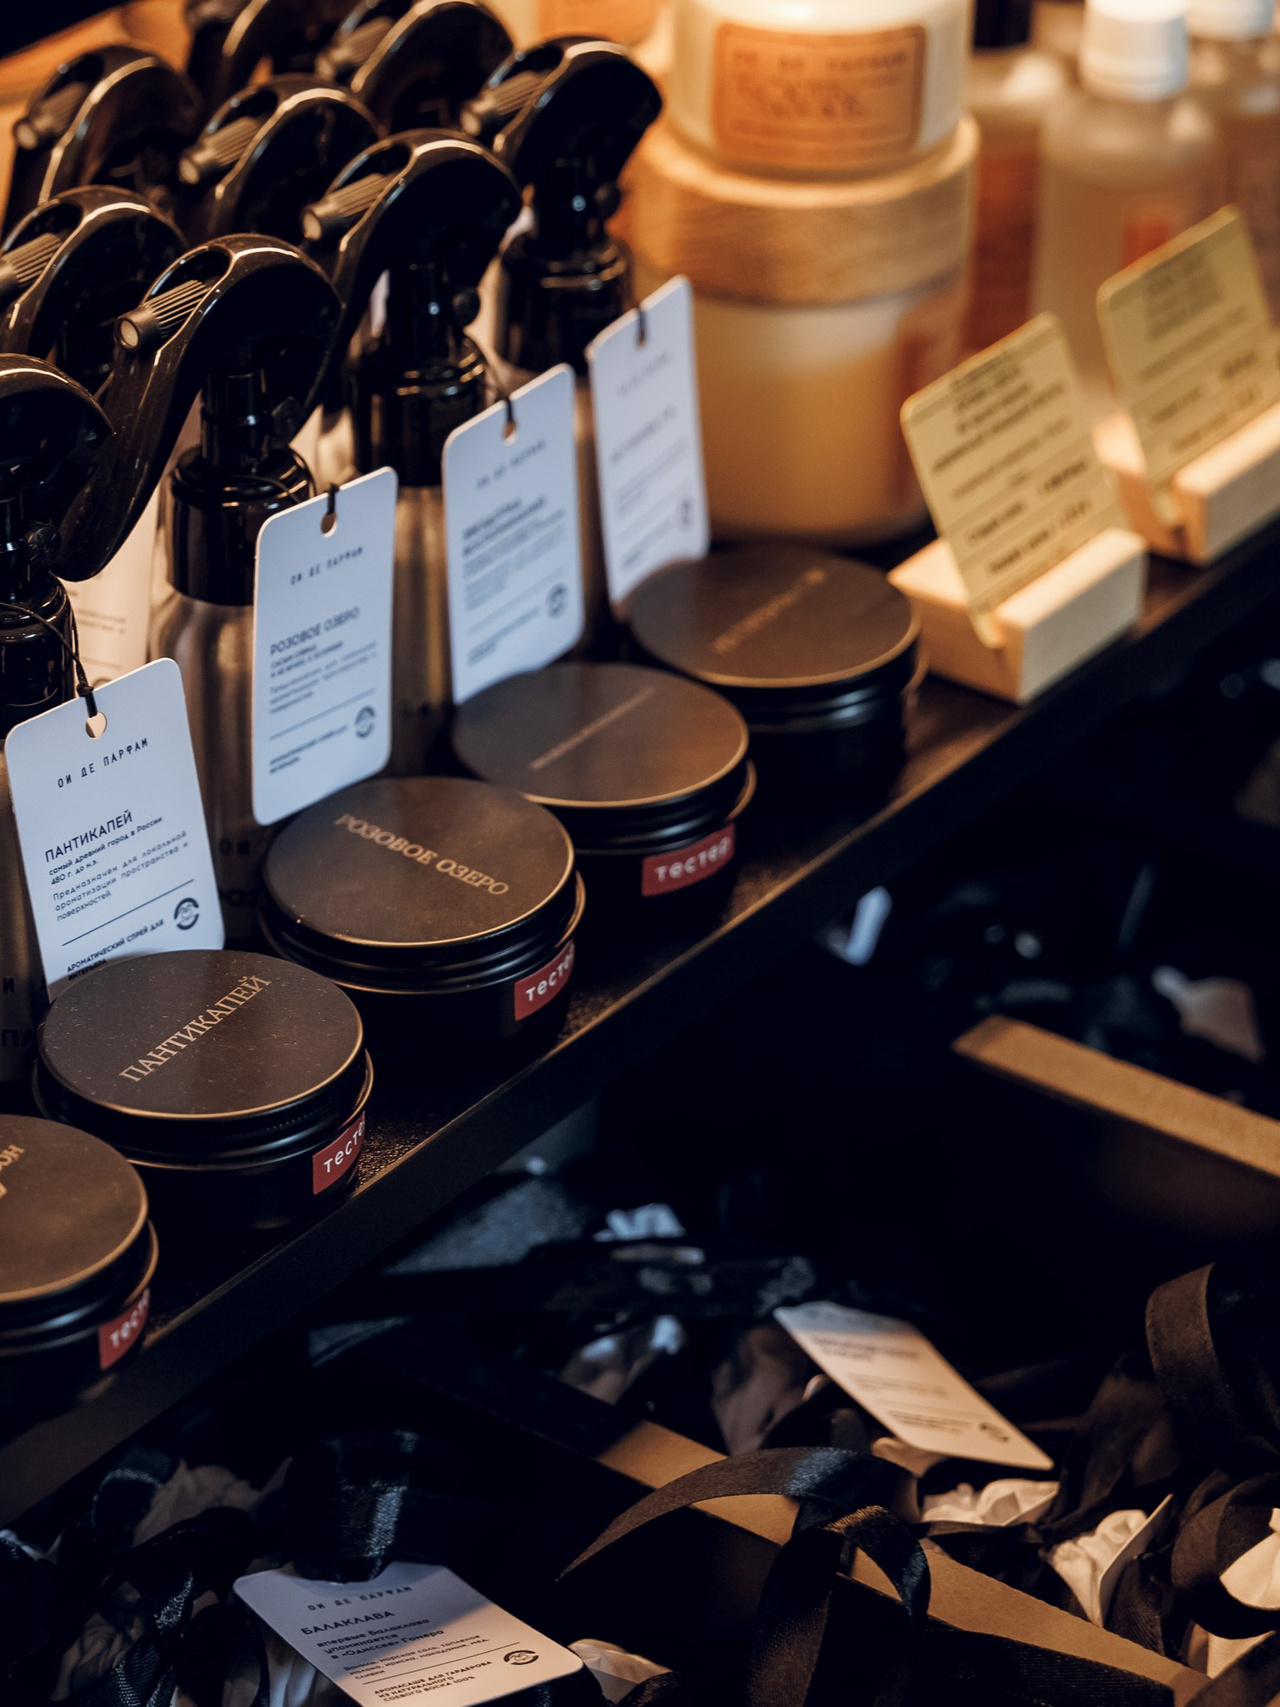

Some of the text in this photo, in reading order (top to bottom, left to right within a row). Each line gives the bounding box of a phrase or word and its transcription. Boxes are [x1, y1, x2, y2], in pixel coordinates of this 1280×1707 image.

[269, 605, 361, 656] РОЗОВОЕ ОЗЕРО
[57, 737, 149, 788] ОИ ДЕ ПАРФАМ
[45, 809, 133, 862] ПАНТИКАПЕЙ
[49, 859, 73, 876] самый
[74, 843, 107, 864] древний
[107, 834, 129, 848] город
[136, 816, 163, 834] России
[333, 813, 510, 896] РОЗОВОЕ ОЗЕРО
[51, 874, 66, 885] 480
[75, 865, 85, 875] до
[53, 829, 187, 901] Предназначен для локальной
[55, 877, 117, 911] ароматизации
[120, 846, 180, 879] пространство
[67, 918, 165, 972] АРОМАТИЧЕСКИЙ СПРЕЙ ДЛЯ
[118, 974, 272, 1083] ПАНТИКАПЕЙ
[300, 1609, 397, 1636] БАЛАКЛАВА
[316, 1618, 432, 1648] впервые Балаклава
[323, 1633, 399, 1655] упоминается
[403, 1628, 445, 1645] Гомера
[374, 1660, 493, 1695] АРОМАСАШЕ ДЛЯ ГАРДЕРОБА
[383, 1675, 476, 1702] СОЕВОГО ВОСКА 100%
[391, 1676, 455, 1695] НАТУРАЛЬНОГО
